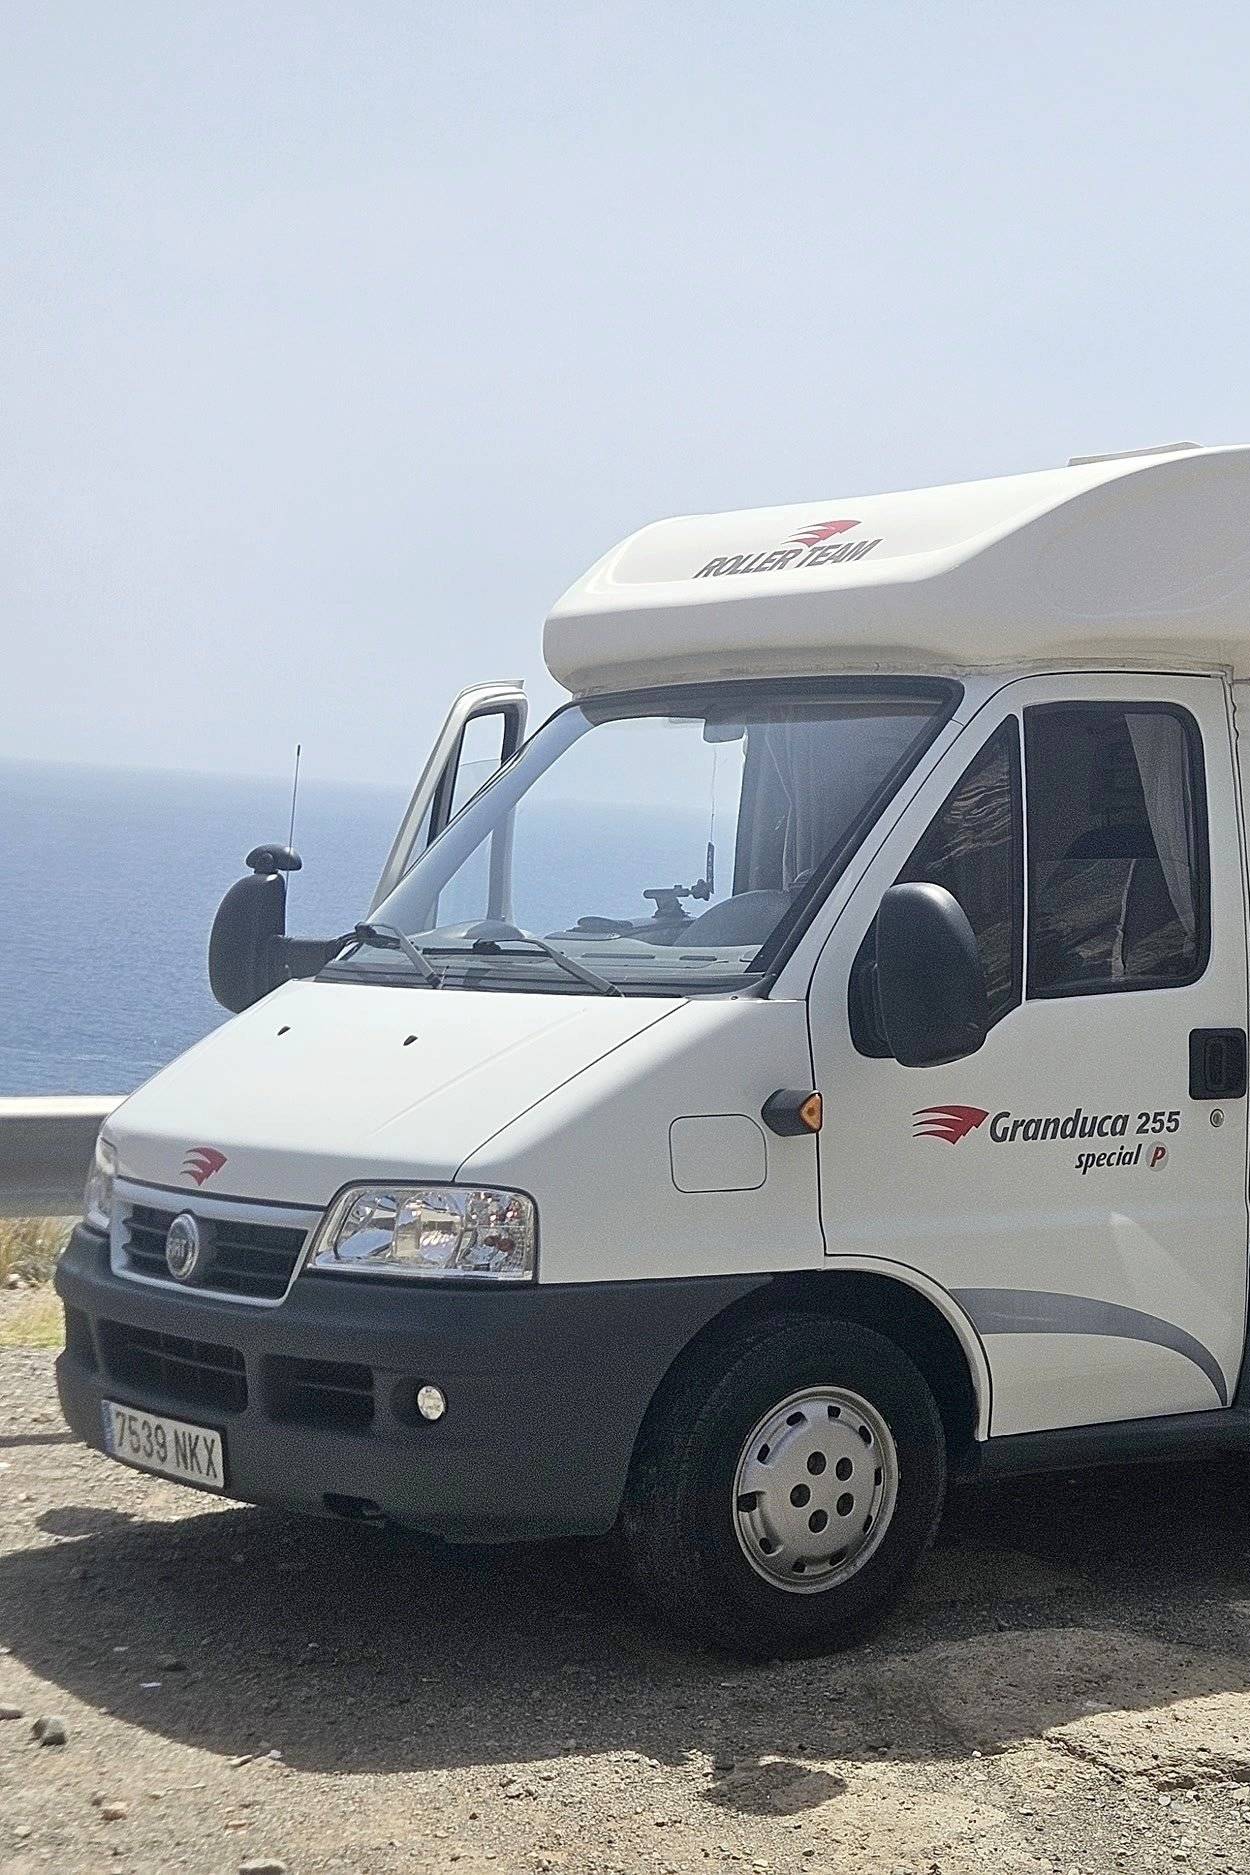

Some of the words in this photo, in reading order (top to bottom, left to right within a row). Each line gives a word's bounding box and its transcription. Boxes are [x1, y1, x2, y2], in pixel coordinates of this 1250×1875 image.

[691, 548, 803, 579] ROLLER
[795, 538, 884, 567] TEAM
[989, 1108, 1129, 1144] Granduca
[1136, 1110, 1181, 1135] 255
[1075, 1143, 1142, 1175] special
[1150, 1146, 1166, 1168] P
[115, 1411, 168, 1463] 7539
[174, 1428, 218, 1479] NKX
